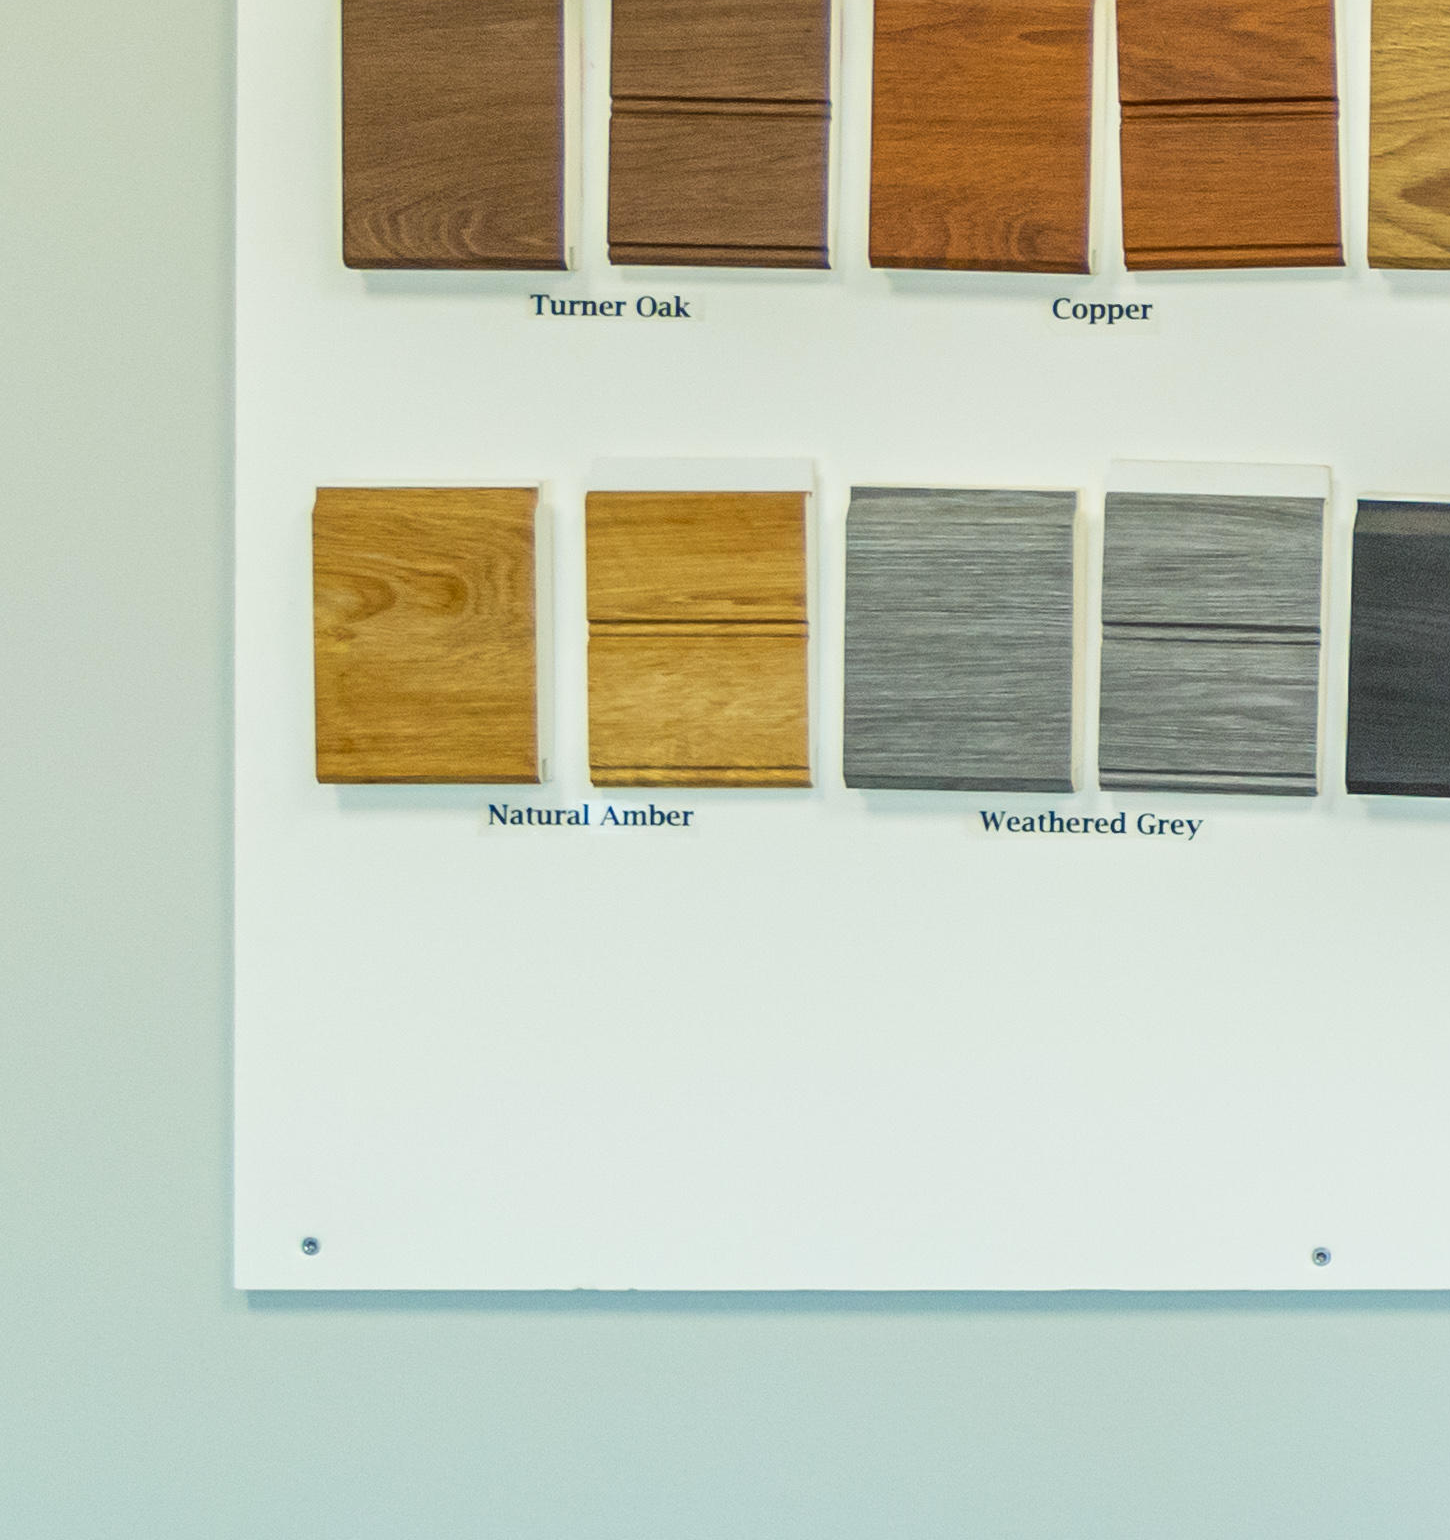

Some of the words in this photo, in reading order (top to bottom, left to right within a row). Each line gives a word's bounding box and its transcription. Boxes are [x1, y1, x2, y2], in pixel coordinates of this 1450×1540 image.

[529, 293, 627, 318] Turner
[636, 295, 692, 319] Oak
[1053, 298, 1152, 324] Copper
[488, 804, 590, 828] Natural
[600, 804, 694, 826] Amber
[980, 811, 1126, 833] Weathered
[1137, 813, 1203, 840] Grey
